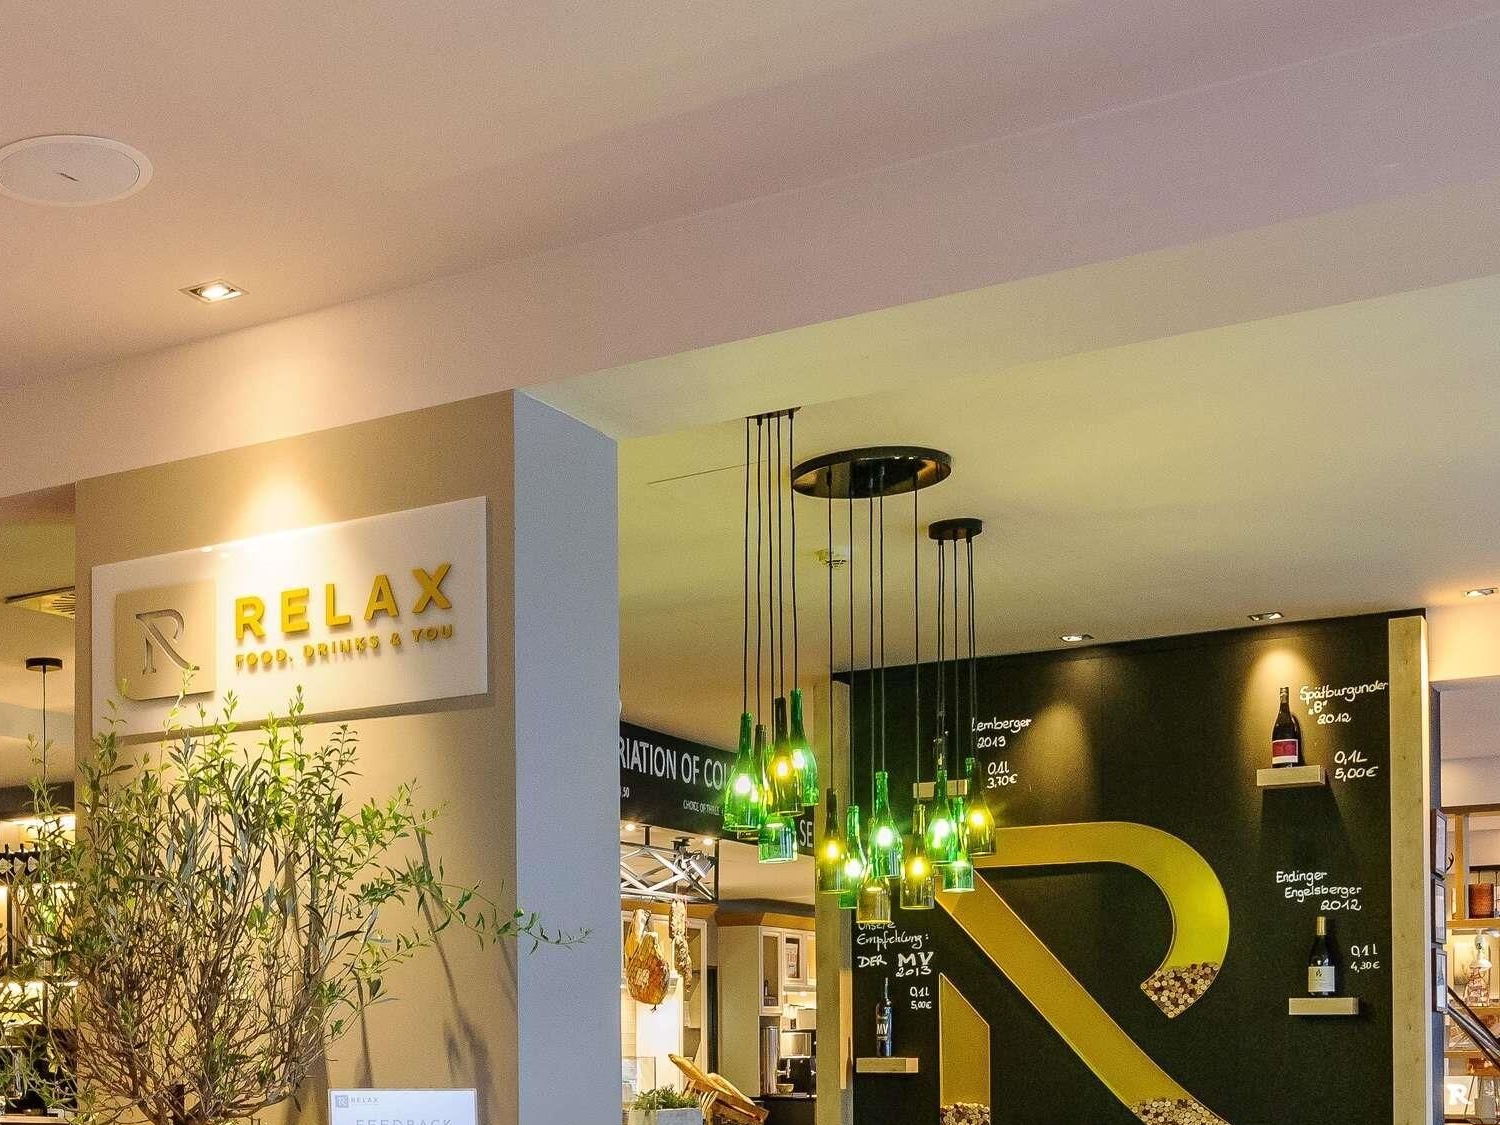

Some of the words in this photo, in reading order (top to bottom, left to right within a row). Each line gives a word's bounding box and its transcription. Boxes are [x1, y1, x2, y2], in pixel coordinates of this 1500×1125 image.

[235, 561, 453, 640] RELAX
[303, 635, 380, 660] DRINKS
[389, 628, 403, 647] &
[412, 623, 454, 643] YOU
[1317, 712, 1352, 725] 2012
[976, 735, 1006, 748] 2013
[681, 752, 700, 785] OF
[1335, 766, 1379, 782] 5,00€
[987, 774, 1018, 789] 3,70€
[1276, 870, 1327, 886] Endinger
[1285, 885, 1362, 902] Engelsberger
[1320, 899, 1362, 911] 2012
[857, 954, 887, 968] DER
[898, 951, 934, 967] MV
[1350, 960, 1381, 973] 4,30€
[895, 965, 932, 977] 2013
[876, 1024, 889, 1035] MV
[350, 1096, 379, 1104] RELAX
